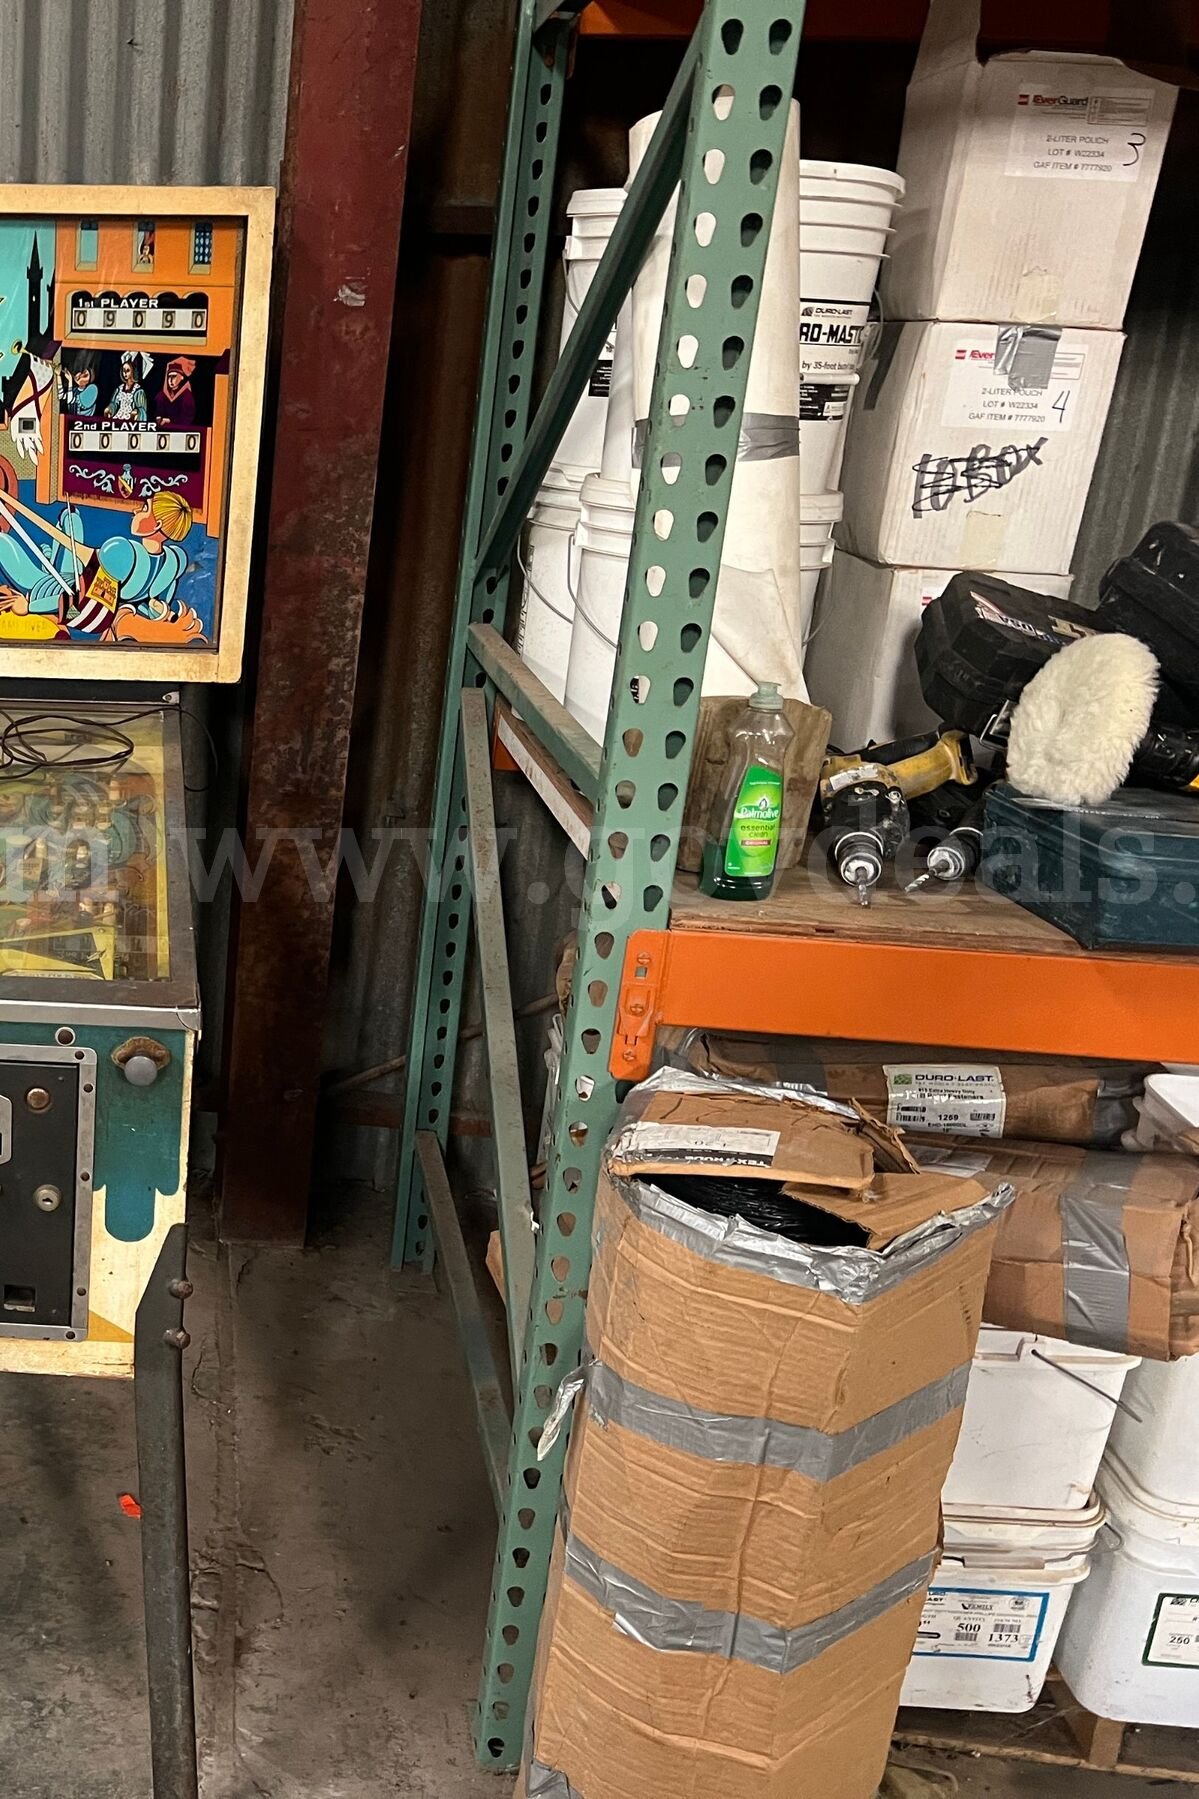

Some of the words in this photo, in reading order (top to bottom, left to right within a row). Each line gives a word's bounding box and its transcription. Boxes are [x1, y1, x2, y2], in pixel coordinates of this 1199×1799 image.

[1046, 134, 1076, 144] 2-LITER
[1079, 136, 1109, 145] POUCH
[1047, 148, 1063, 156] LOT
[1122, 132, 1147, 167] 3
[78, 298, 94, 308] 1st
[100, 298, 159, 308] PLAYER
[76, 310, 86, 327] 0
[106, 310, 115, 328] 9
[134, 311, 144, 328] 0
[164, 311, 174, 329] 9
[194, 311, 204, 328] 0
[981, 387, 1011, 396] 2-LITER
[1014, 388, 1043, 397] POUCH
[983, 400, 999, 408] LOT
[1051, 389, 1071, 424] 4
[968, 412, 985, 420] GAF
[986, 413, 1006, 421] ITEM
[1007, 413, 1013, 421] #
[1014, 414, 1046, 423] 7777920
[73, 421, 97, 431] 2nd
[101, 421, 157, 432] PLAYER
[72, 432, 82, 449] 0
[101, 433, 110, 449] 0
[130, 433, 139, 450] 0
[158, 434, 167, 450] 0
[187, 434, 197, 450] 0
[741, 807, 780, 819] Palmolive
[740, 823, 776, 832] essential
[956, 1622, 981, 1633] 500
[988, 1633, 1018, 1643] 1373
